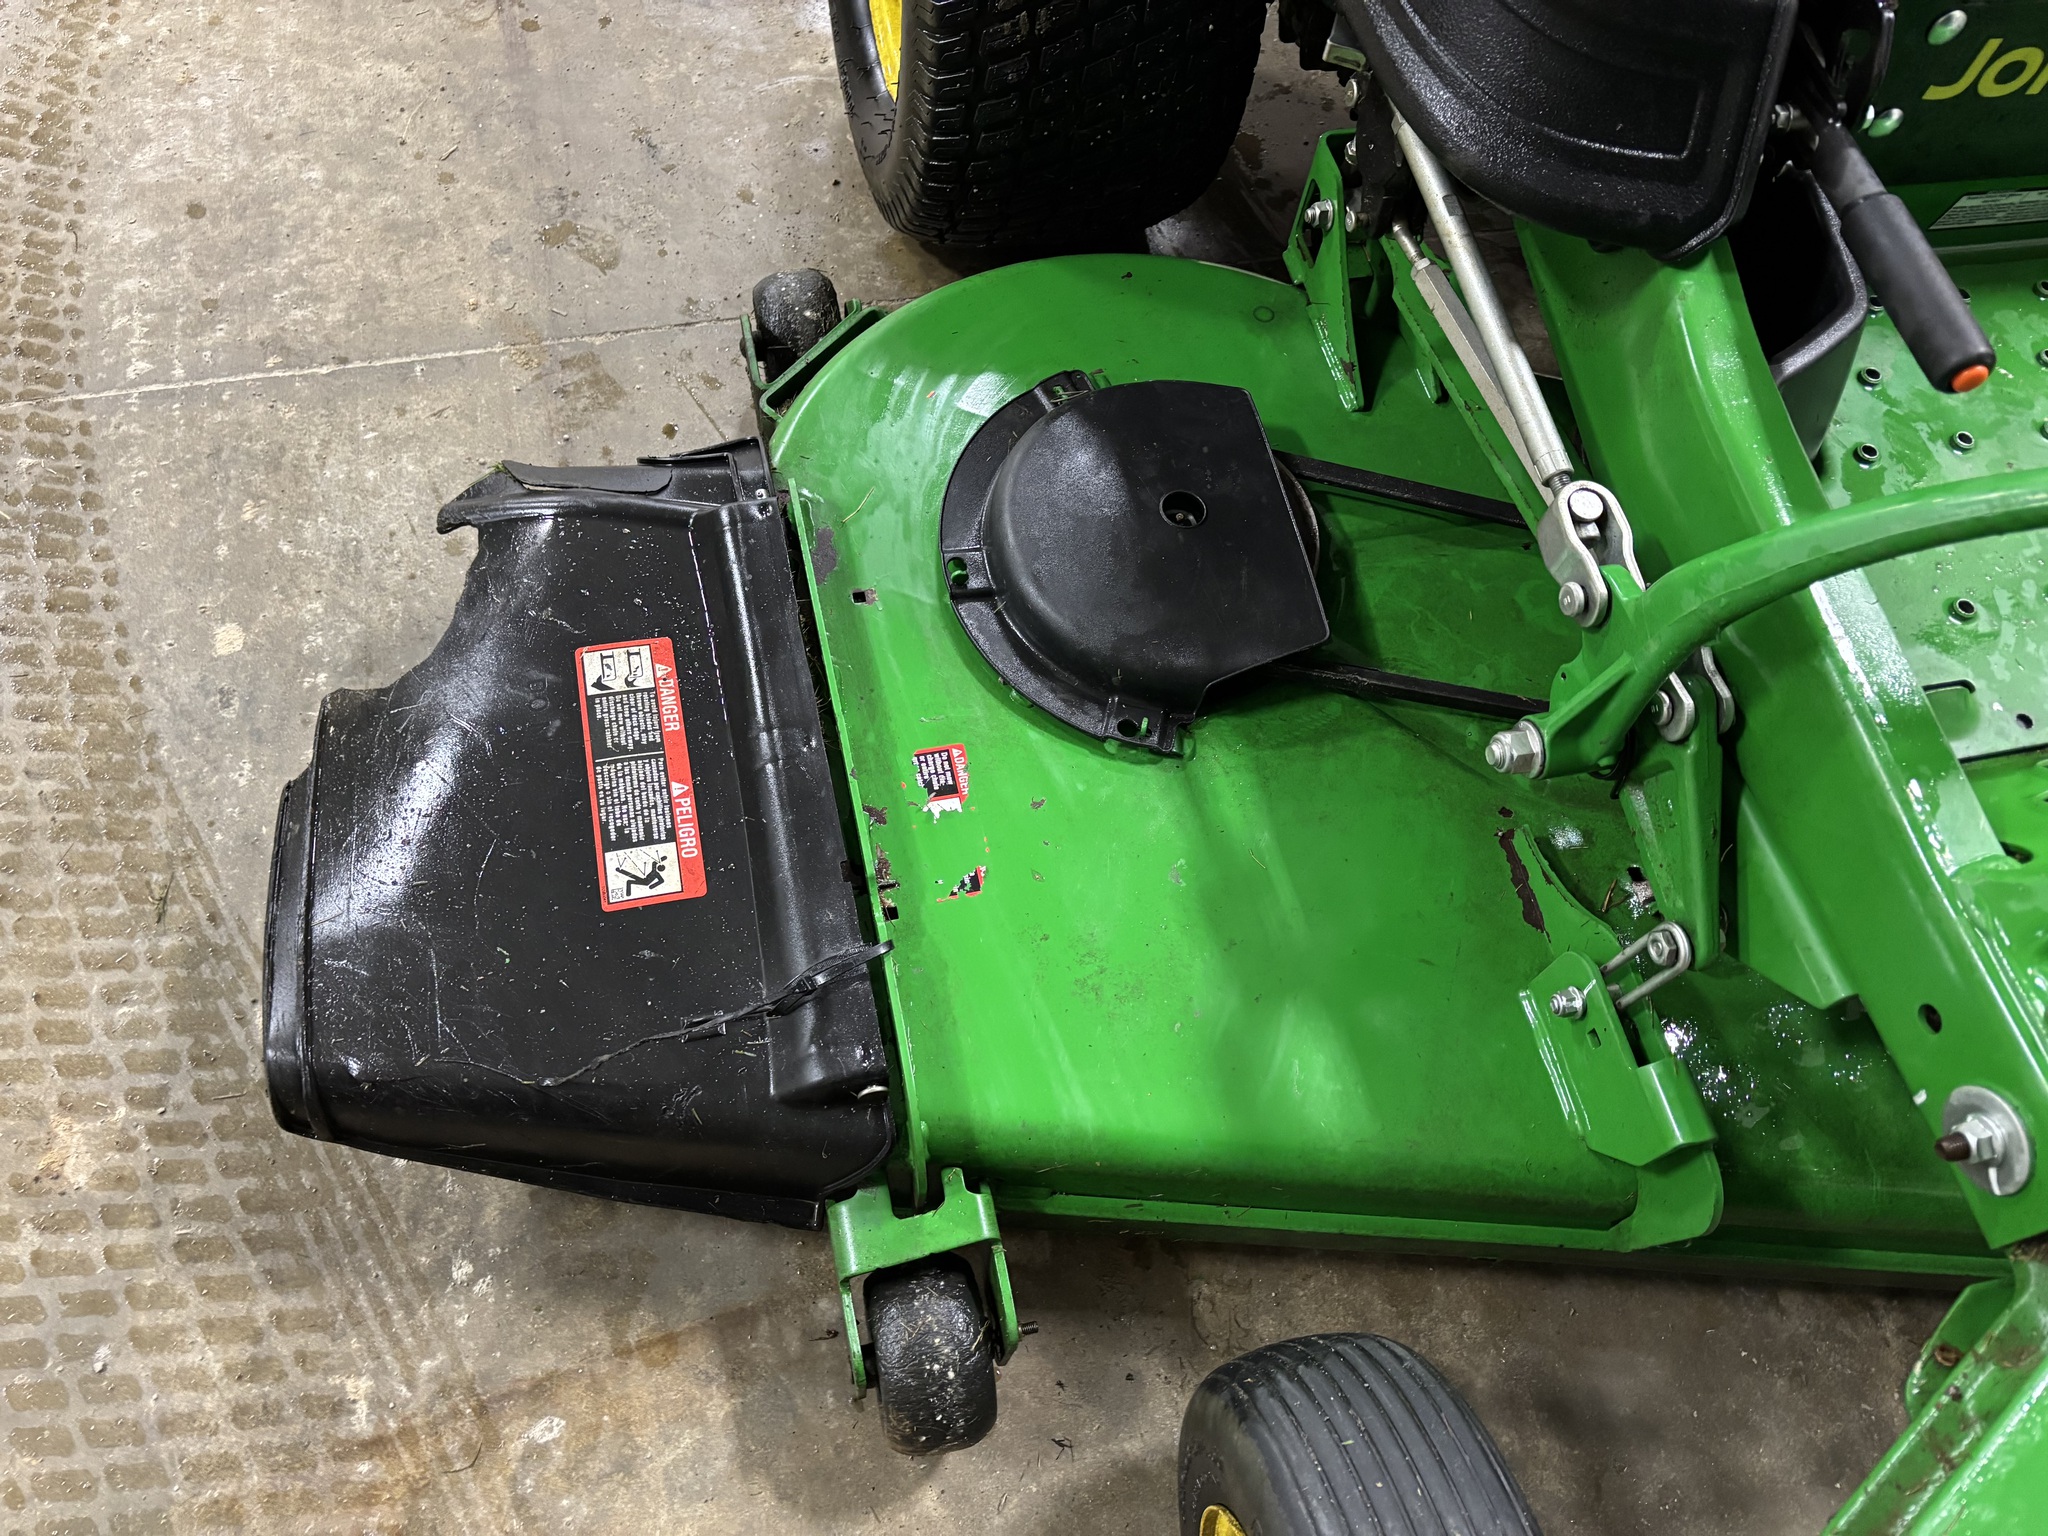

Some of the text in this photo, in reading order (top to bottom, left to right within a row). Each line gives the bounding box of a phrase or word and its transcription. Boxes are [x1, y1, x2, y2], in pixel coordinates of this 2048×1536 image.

[1922, 38, 2048, 99] JO
[600, 696, 608, 712] entire
[608, 696, 616, 721] discharge
[650, 699, 658, 713] avoid
[659, 679, 680, 731] DANGER
[602, 713, 610, 728] grass
[611, 722, 619, 736] chute
[645, 713, 653, 730] blades
[619, 726, 627, 745] without
[934, 753, 944, 774] without
[941, 752, 948, 760] Do
[629, 761, 638, 788] plataforma
[644, 764, 652, 782] objetos
[651, 758, 659, 781] causadas
[921, 763, 930, 779] entire
[926, 754, 939, 790] charge chute
[943, 761, 951, 770] not
[639, 781, 647, 790] del
[621, 804, 628, 813] No
[626, 794, 635, 818] personas
[608, 813, 616, 841] recogedor
[675, 797, 698, 858] PELIGRO
